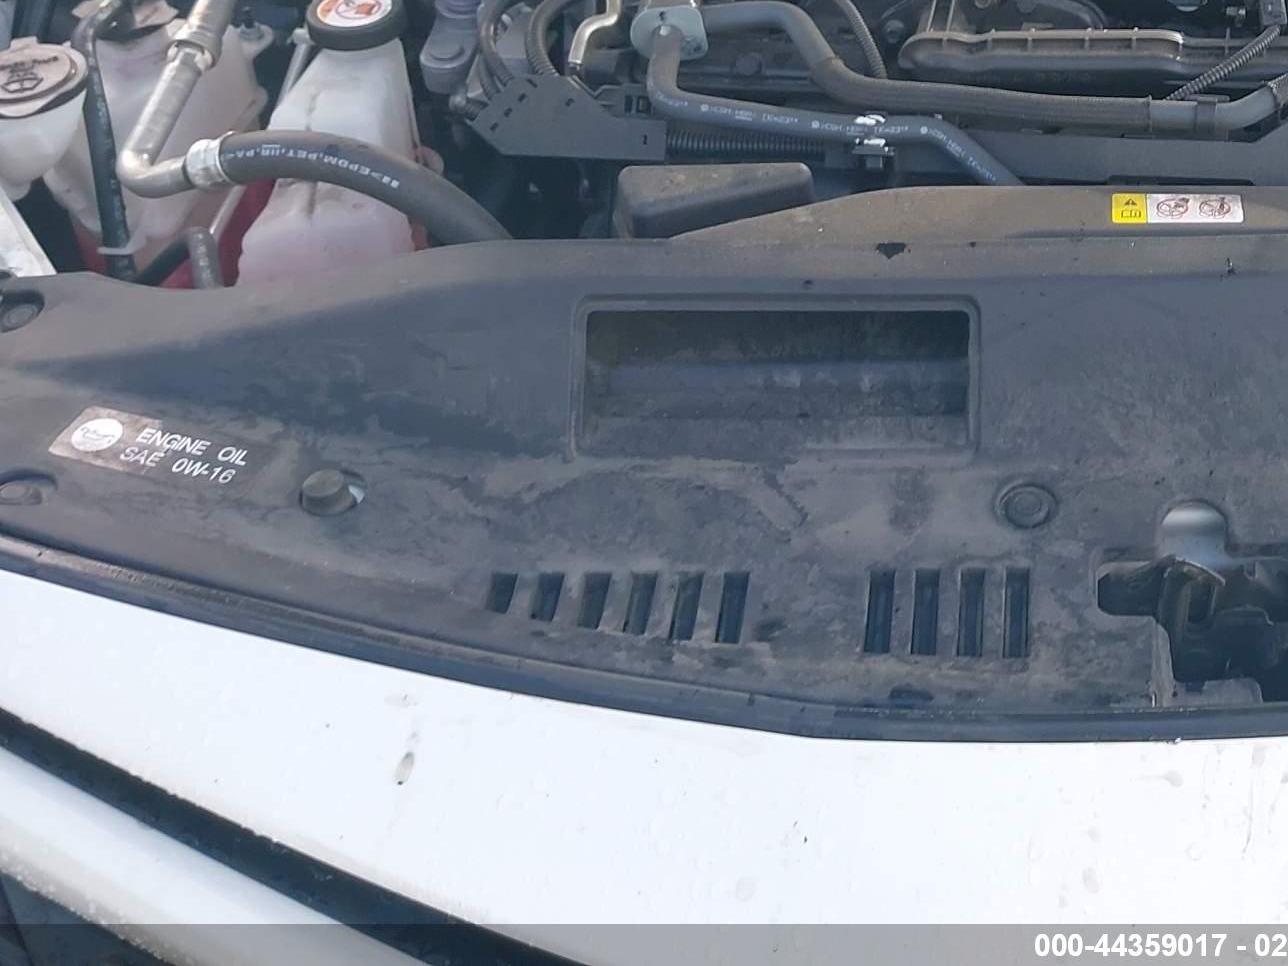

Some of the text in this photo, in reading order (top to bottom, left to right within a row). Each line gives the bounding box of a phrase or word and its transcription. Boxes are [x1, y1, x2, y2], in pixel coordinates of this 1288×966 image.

[120, 446, 236, 484] SAE 0W-16
[135, 427, 248, 466] ENGINE OIL
